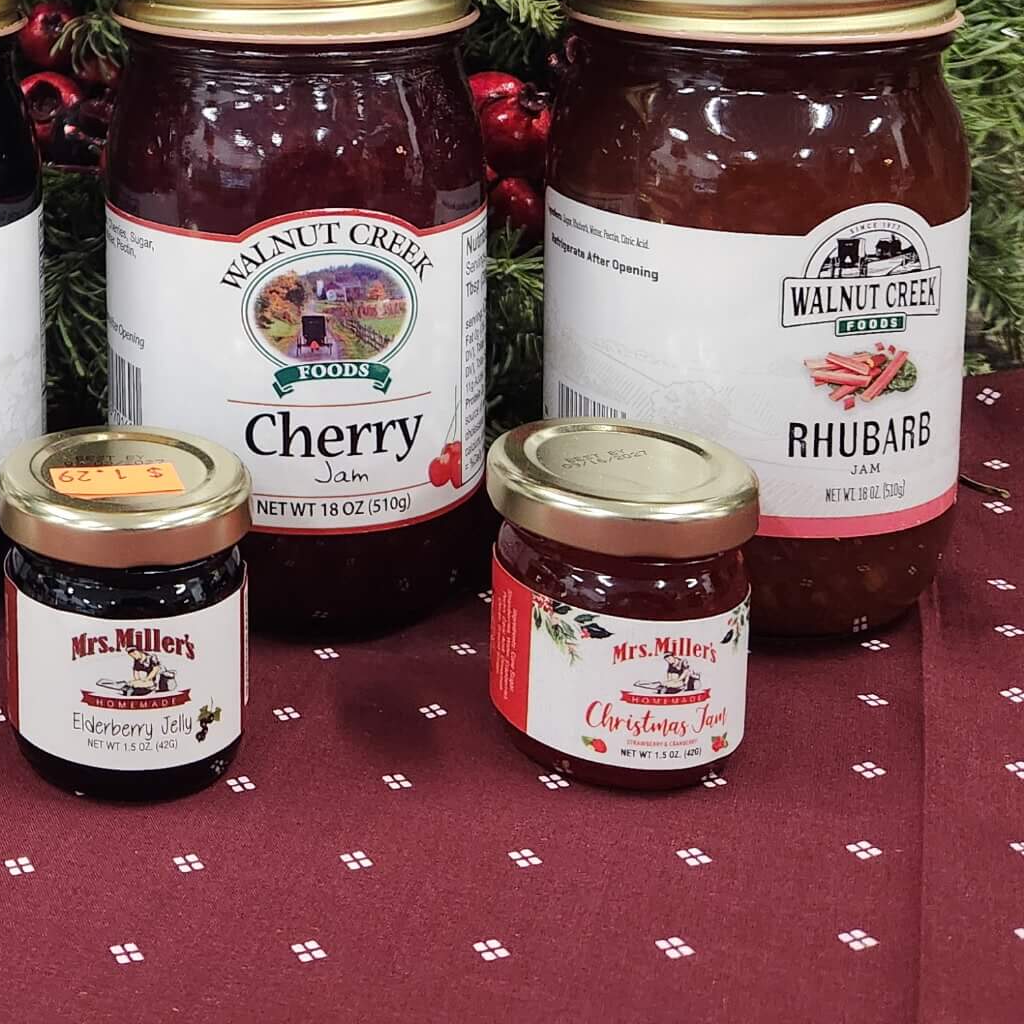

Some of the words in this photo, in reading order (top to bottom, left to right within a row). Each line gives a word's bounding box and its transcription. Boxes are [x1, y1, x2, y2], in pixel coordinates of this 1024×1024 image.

[129, 231, 155, 252] Sugar,
[220, 221, 340, 290] WALNUT
[349, 223, 434, 282] CREEK
[551, 231, 585, 259] Refrigerate
[586, 250, 610, 270] After
[611, 258, 660, 283] Opening
[791, 284, 879, 317] WALNUT
[885, 276, 937, 310] CREEK
[118, 323, 145, 350] Opening
[846, 320, 898, 333] FOODS
[298, 364, 370, 379] FOODS
[245, 411, 423, 463] Cherry
[788, 410, 931, 458] RHUBARB
[146, 466, 164, 479] $
[314, 460, 369, 484] Jam
[850, 462, 881, 476] JAM
[256, 500, 287, 516] NET
[290, 501, 317, 517] WT
[320, 501, 339, 517] 18
[342, 500, 364, 516] OZ
[368, 492, 411, 516] (510g)
[825, 488, 841, 503] NET
[858, 486, 868, 501] 18
[95, 699, 177, 709] HOMEMADE
[72, 712, 153, 741] Elderberry
[160, 714, 193, 736] Jelly
[585, 700, 688, 737] Christmas
[691, 703, 727, 734] Jam
[88, 739, 103, 750] NET
[106, 740, 120, 751] WT
[155, 737, 178, 752] (42G)
[620, 748, 636, 757] NET
[639, 750, 652, 759] WT
[683, 747, 702, 759] (42G)
